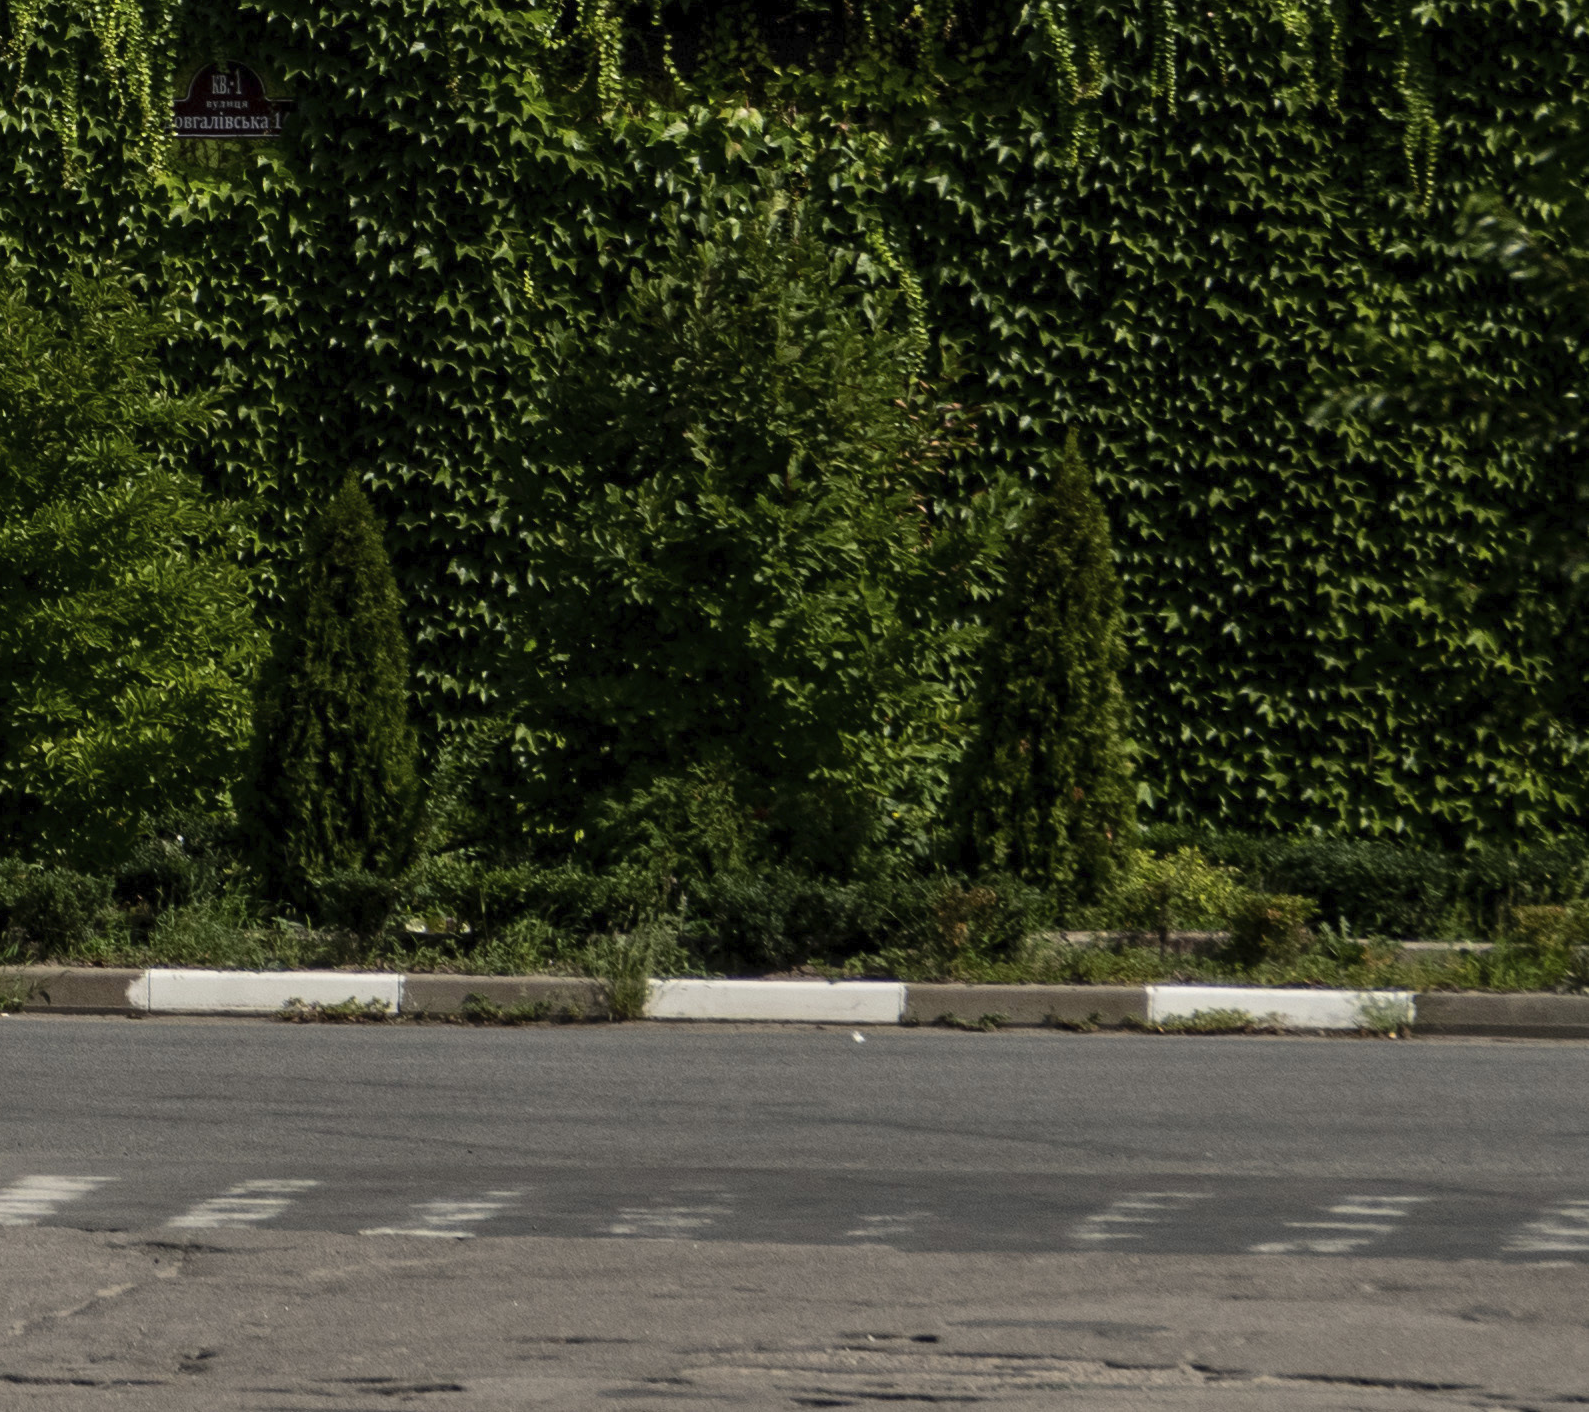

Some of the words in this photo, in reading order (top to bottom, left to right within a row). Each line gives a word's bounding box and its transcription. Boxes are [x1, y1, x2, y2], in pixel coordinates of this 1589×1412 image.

[206, 100, 248, 110] вулиця
[165, 111, 269, 129] овгалівська
[273, 112, 290, 129] 1
